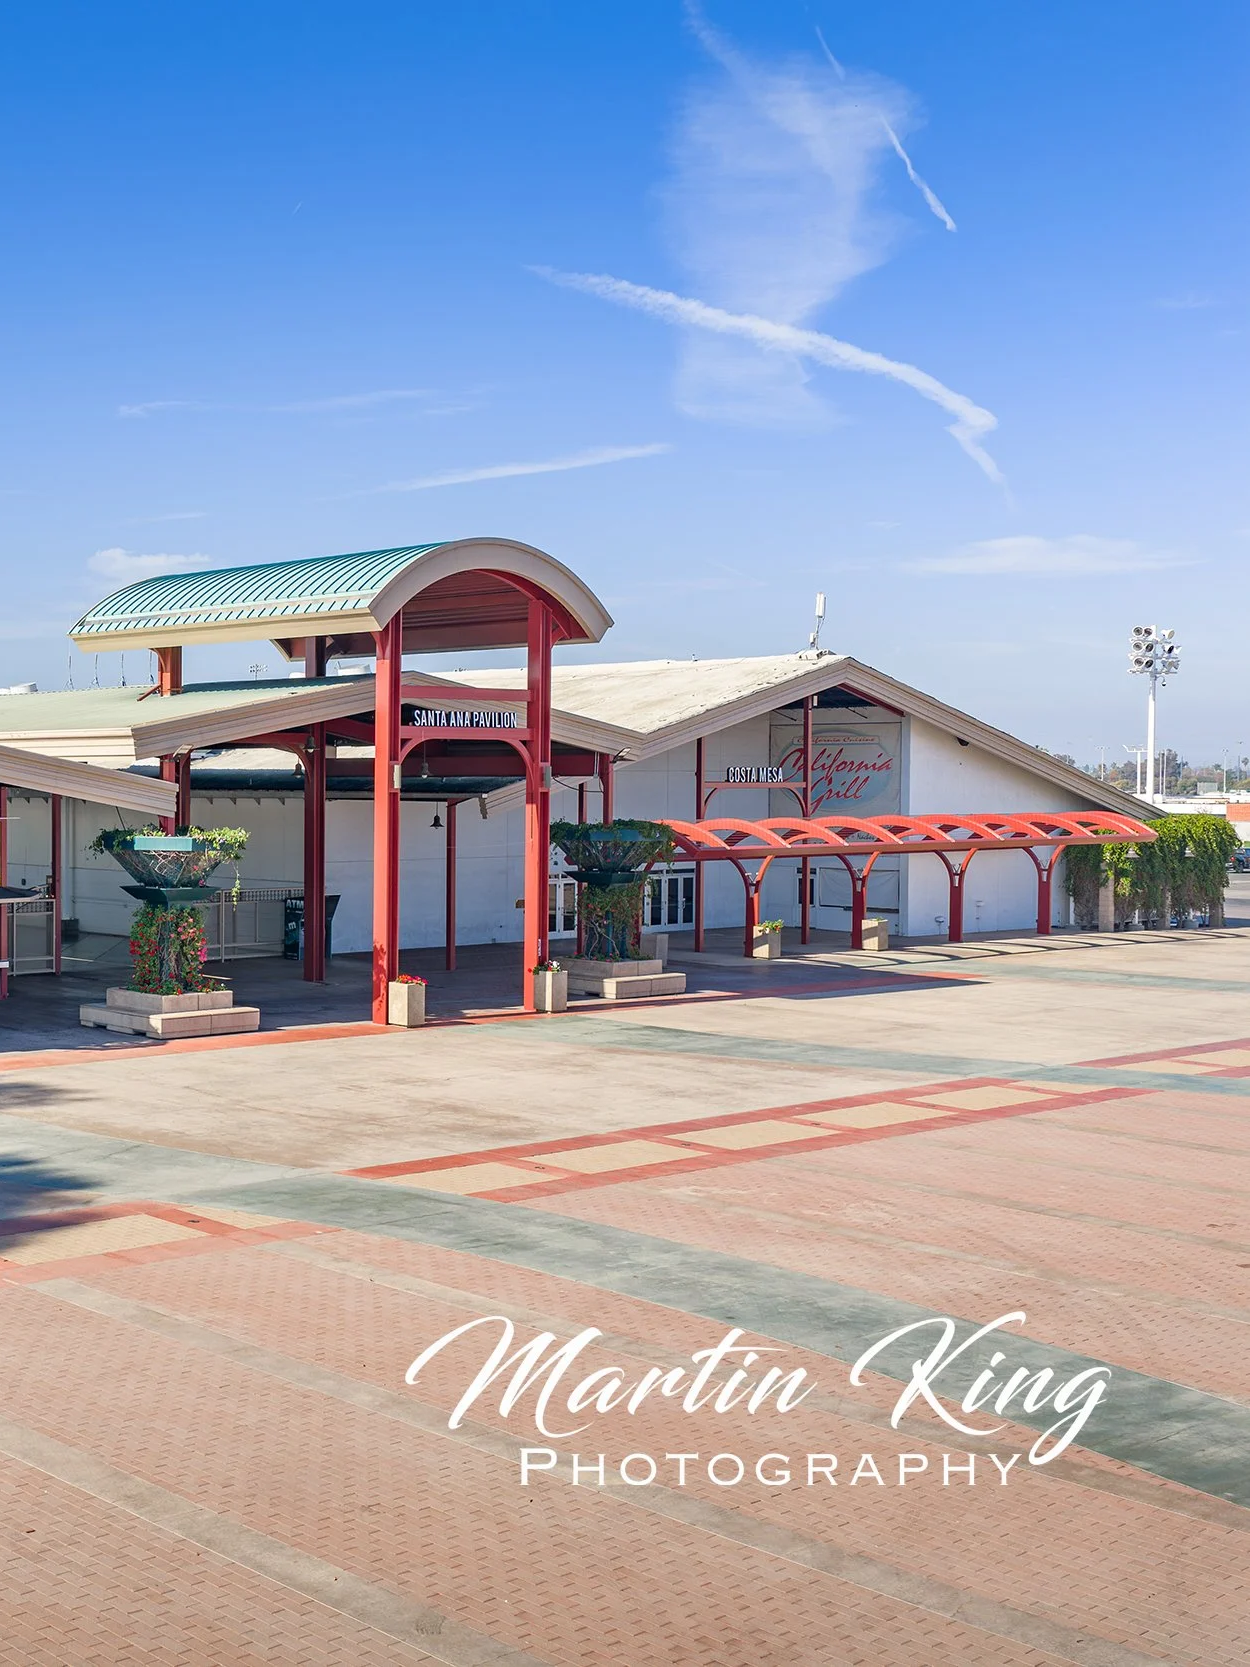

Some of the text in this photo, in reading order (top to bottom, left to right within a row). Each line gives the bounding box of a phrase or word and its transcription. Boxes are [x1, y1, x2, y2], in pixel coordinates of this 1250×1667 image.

[414, 709, 517, 729] SANTA ANA PAVILION
[728, 767, 784, 783] COSTA MESA
[286, 899, 304, 909] ATM
